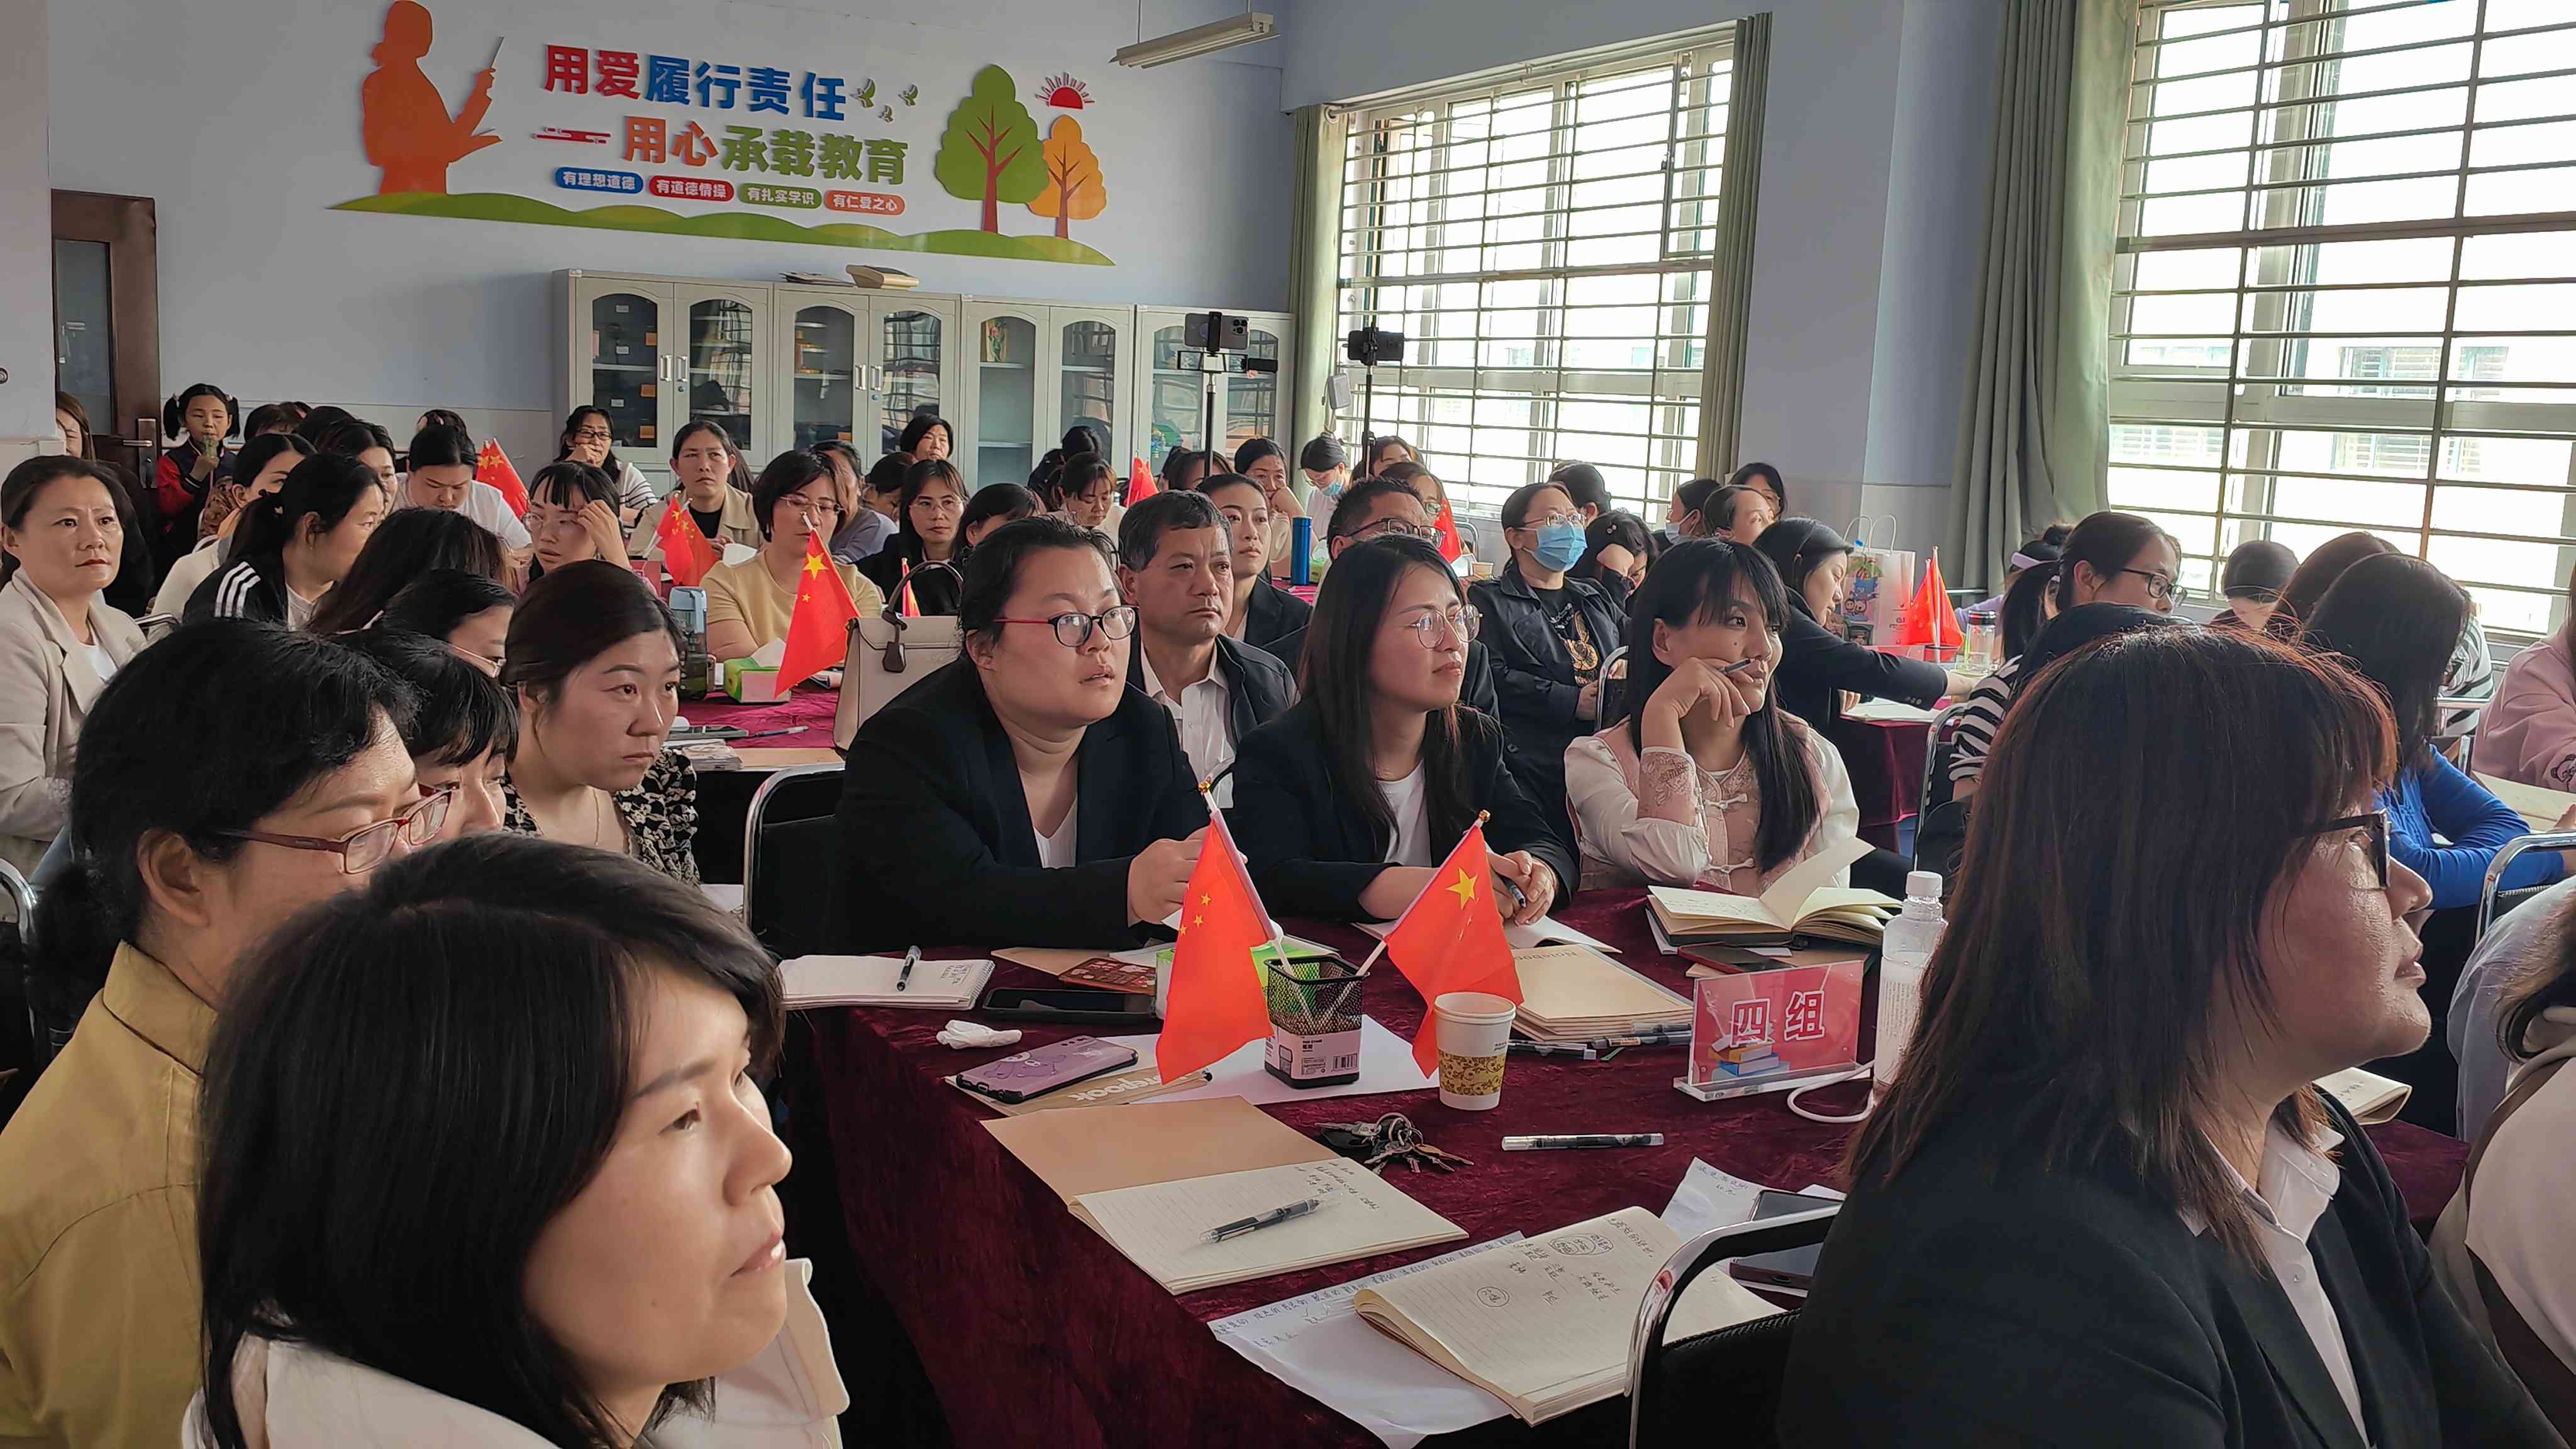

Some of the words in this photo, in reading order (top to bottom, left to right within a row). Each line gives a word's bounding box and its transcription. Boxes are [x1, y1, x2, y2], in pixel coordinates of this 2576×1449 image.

[543, 44, 847, 121] 用爱履行责任
[623, 116, 909, 185] 用心承载教育
[564, 171, 635, 190] 有理想道德
[657, 180, 727, 198] 有道德情操
[747, 187, 815, 205] 有扎实学识
[833, 194, 898, 212] 有仁爱之心
[1729, 990, 1826, 1048] 四组
